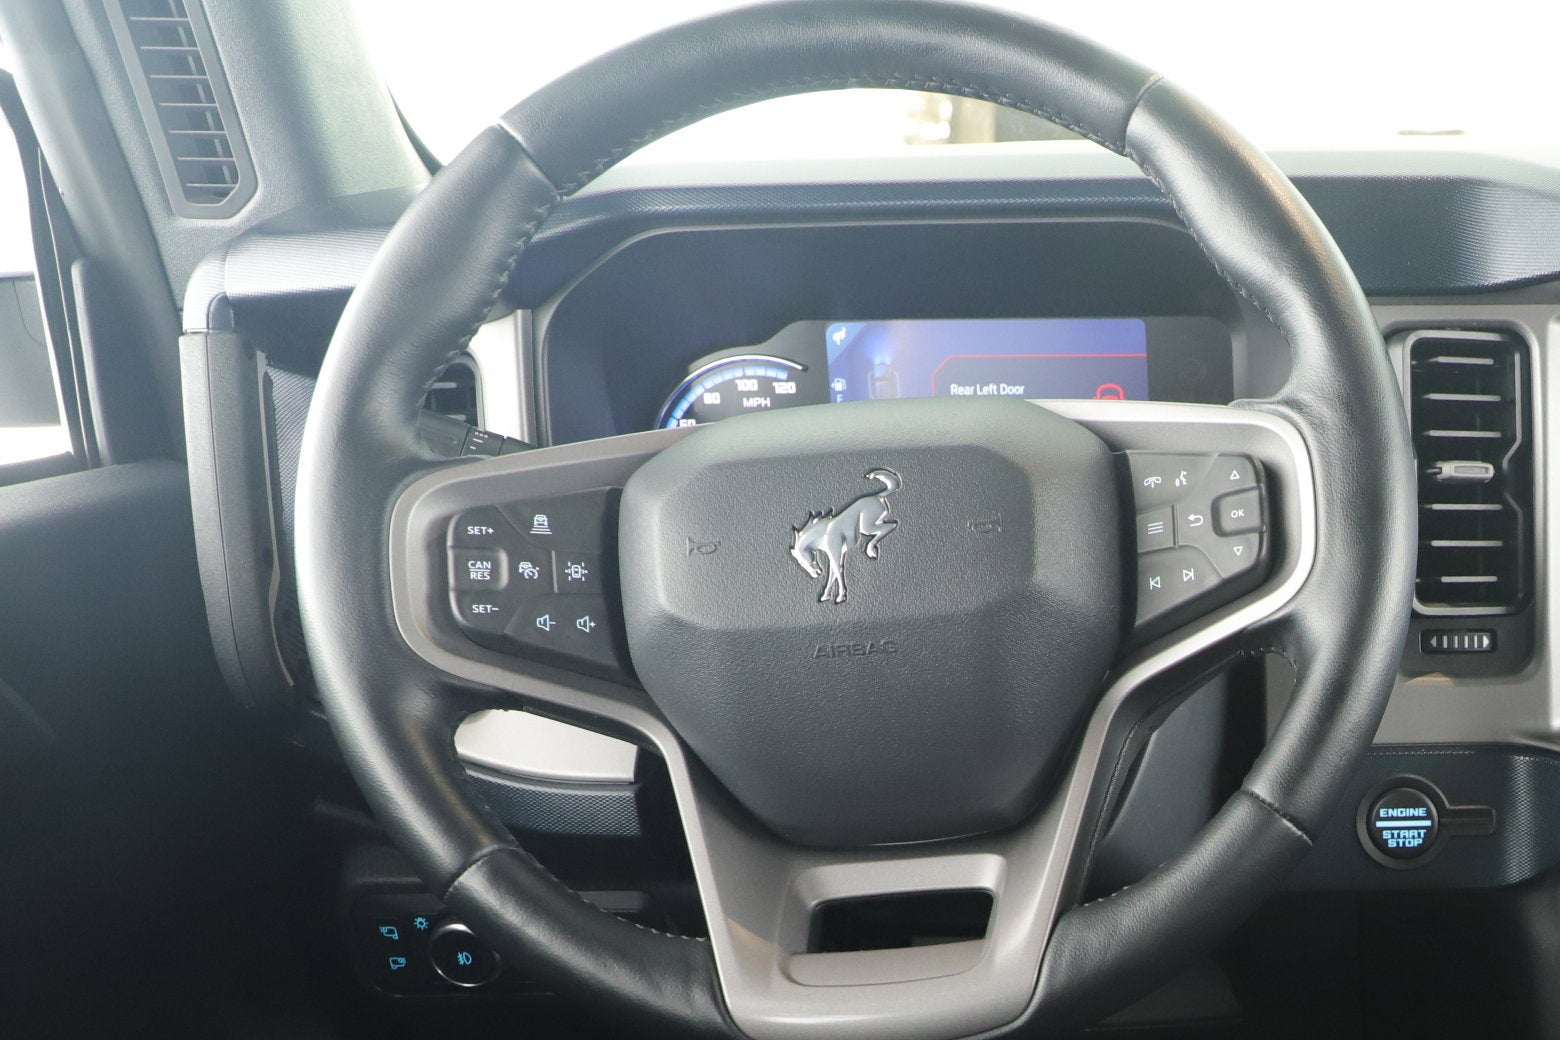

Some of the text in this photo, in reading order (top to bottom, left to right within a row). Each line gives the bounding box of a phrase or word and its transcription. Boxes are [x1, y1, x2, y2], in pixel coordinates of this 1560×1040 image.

[735, 379, 758, 391] 100
[772, 382, 796, 394] 120
[950, 383, 1025, 396] Rear Left Door
[743, 397, 770, 408] MPH
[1231, 508, 1245, 518] OK
[467, 526, 494, 535] SET+
[468, 560, 491, 569] CAN
[470, 571, 490, 580] RES
[812, 640, 898, 659] AIRBAG
[1379, 807, 1427, 818] ENGINE
[1382, 829, 1426, 839] START
[1388, 838, 1423, 848] STOP
